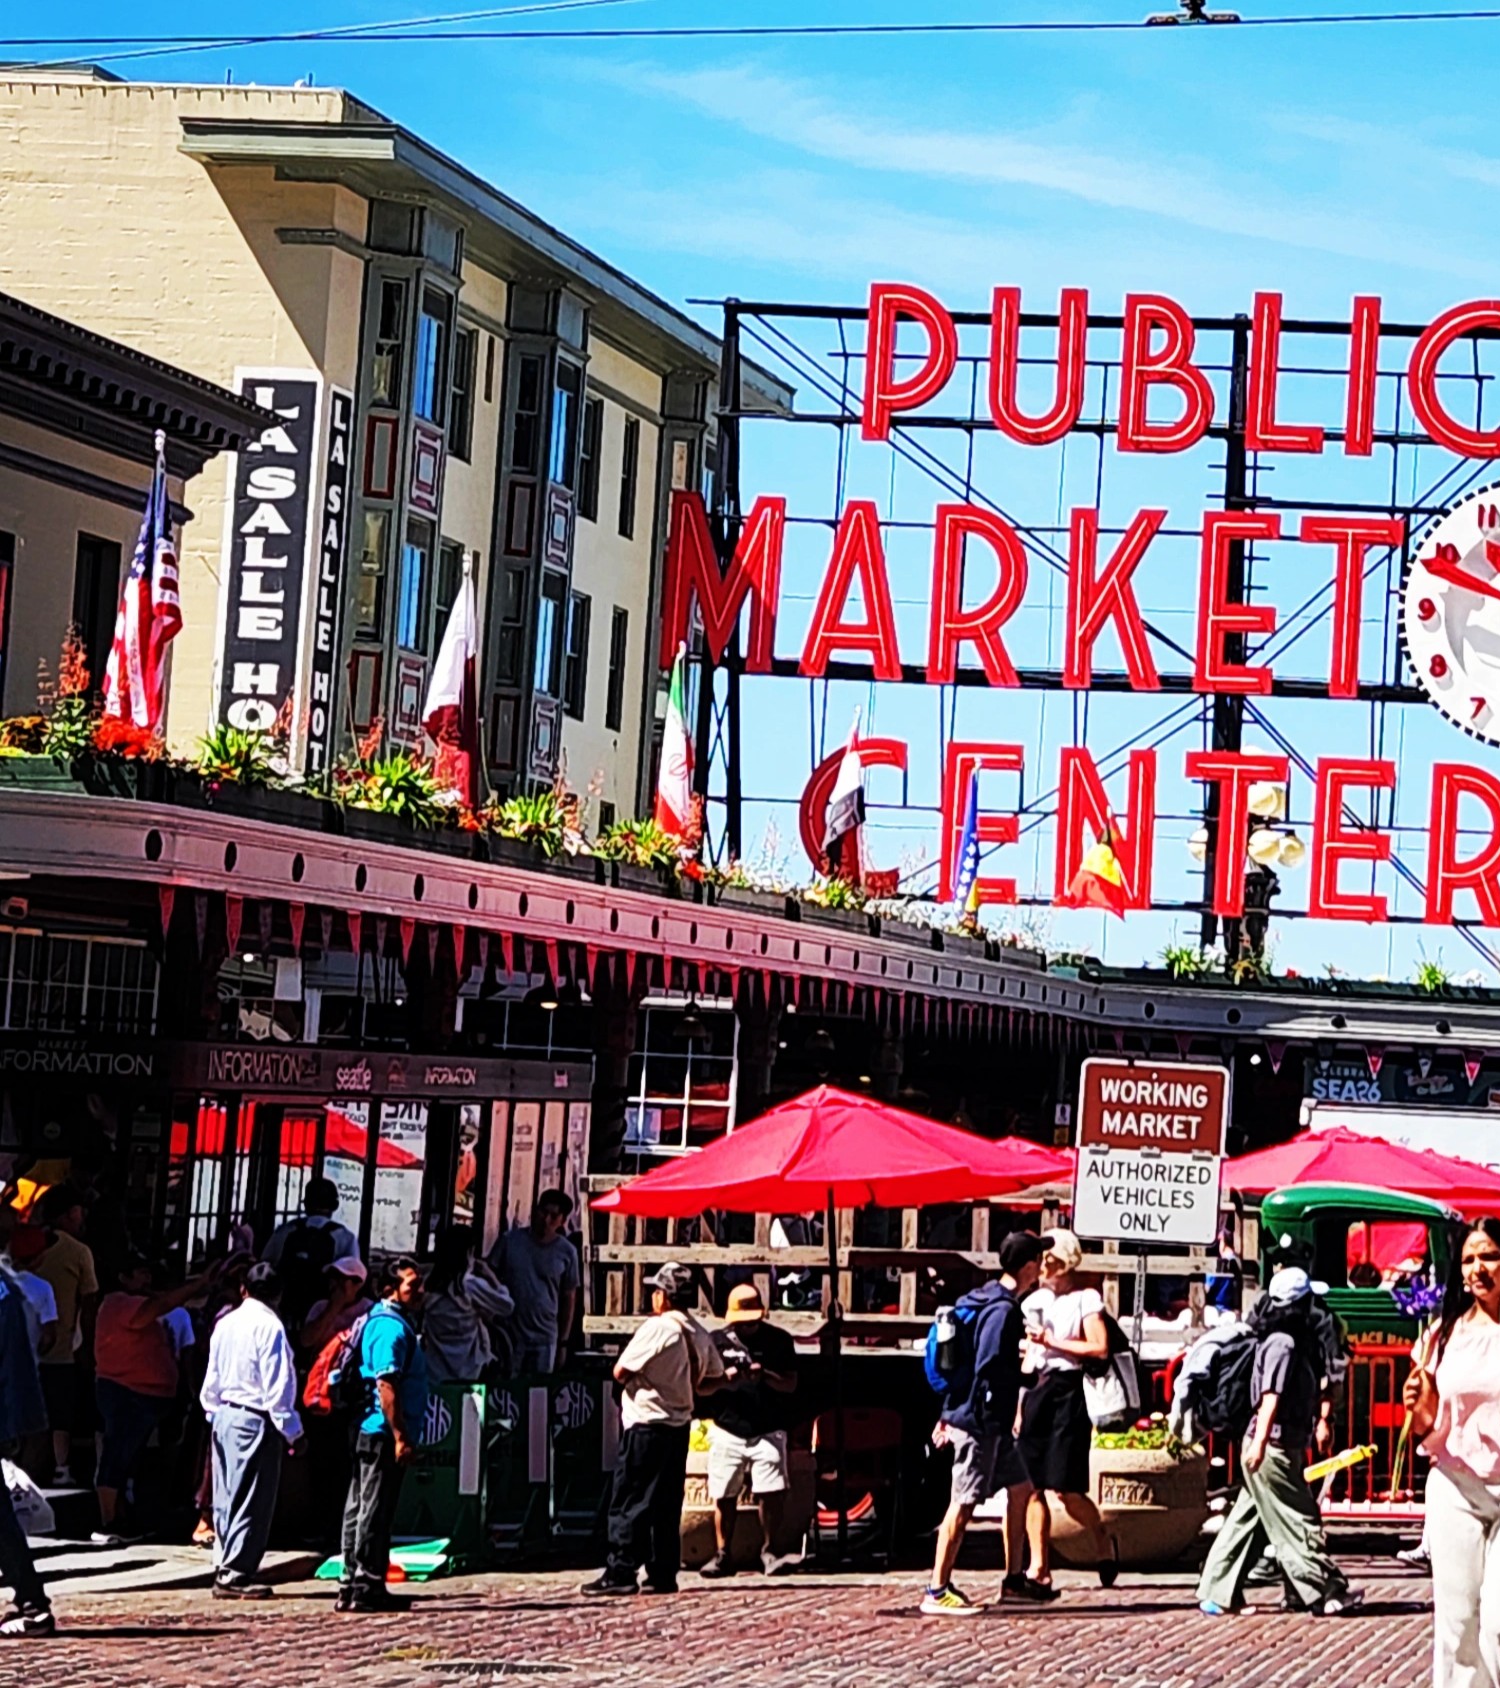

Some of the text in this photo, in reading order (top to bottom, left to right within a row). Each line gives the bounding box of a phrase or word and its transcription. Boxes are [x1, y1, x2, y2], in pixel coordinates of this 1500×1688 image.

[246, 386, 300, 454] LA
[330, 399, 347, 466] LA
[1478, 504, 1497, 528] 11
[237, 466, 297, 641] SALLE
[316, 485, 343, 652] SALLE
[660, 490, 1405, 699] MARKET
[1418, 598, 1435, 621] 9
[1430, 654, 1447, 677] 8
[1470, 697, 1486, 719] 7
[0, 1049, 153, 1077] FORMATION
[207, 1050, 300, 1083] INFORMATION
[1101, 1078, 1209, 1109] WORKING
[1312, 1077, 1382, 1103] SEA26
[1102, 1109, 1202, 1141] MARKET
[1086, 1159, 1212, 1185] AUTHORIZED
[1100, 1185, 1195, 1209] VEHICLES
[1119, 1211, 1171, 1233] ONLY
